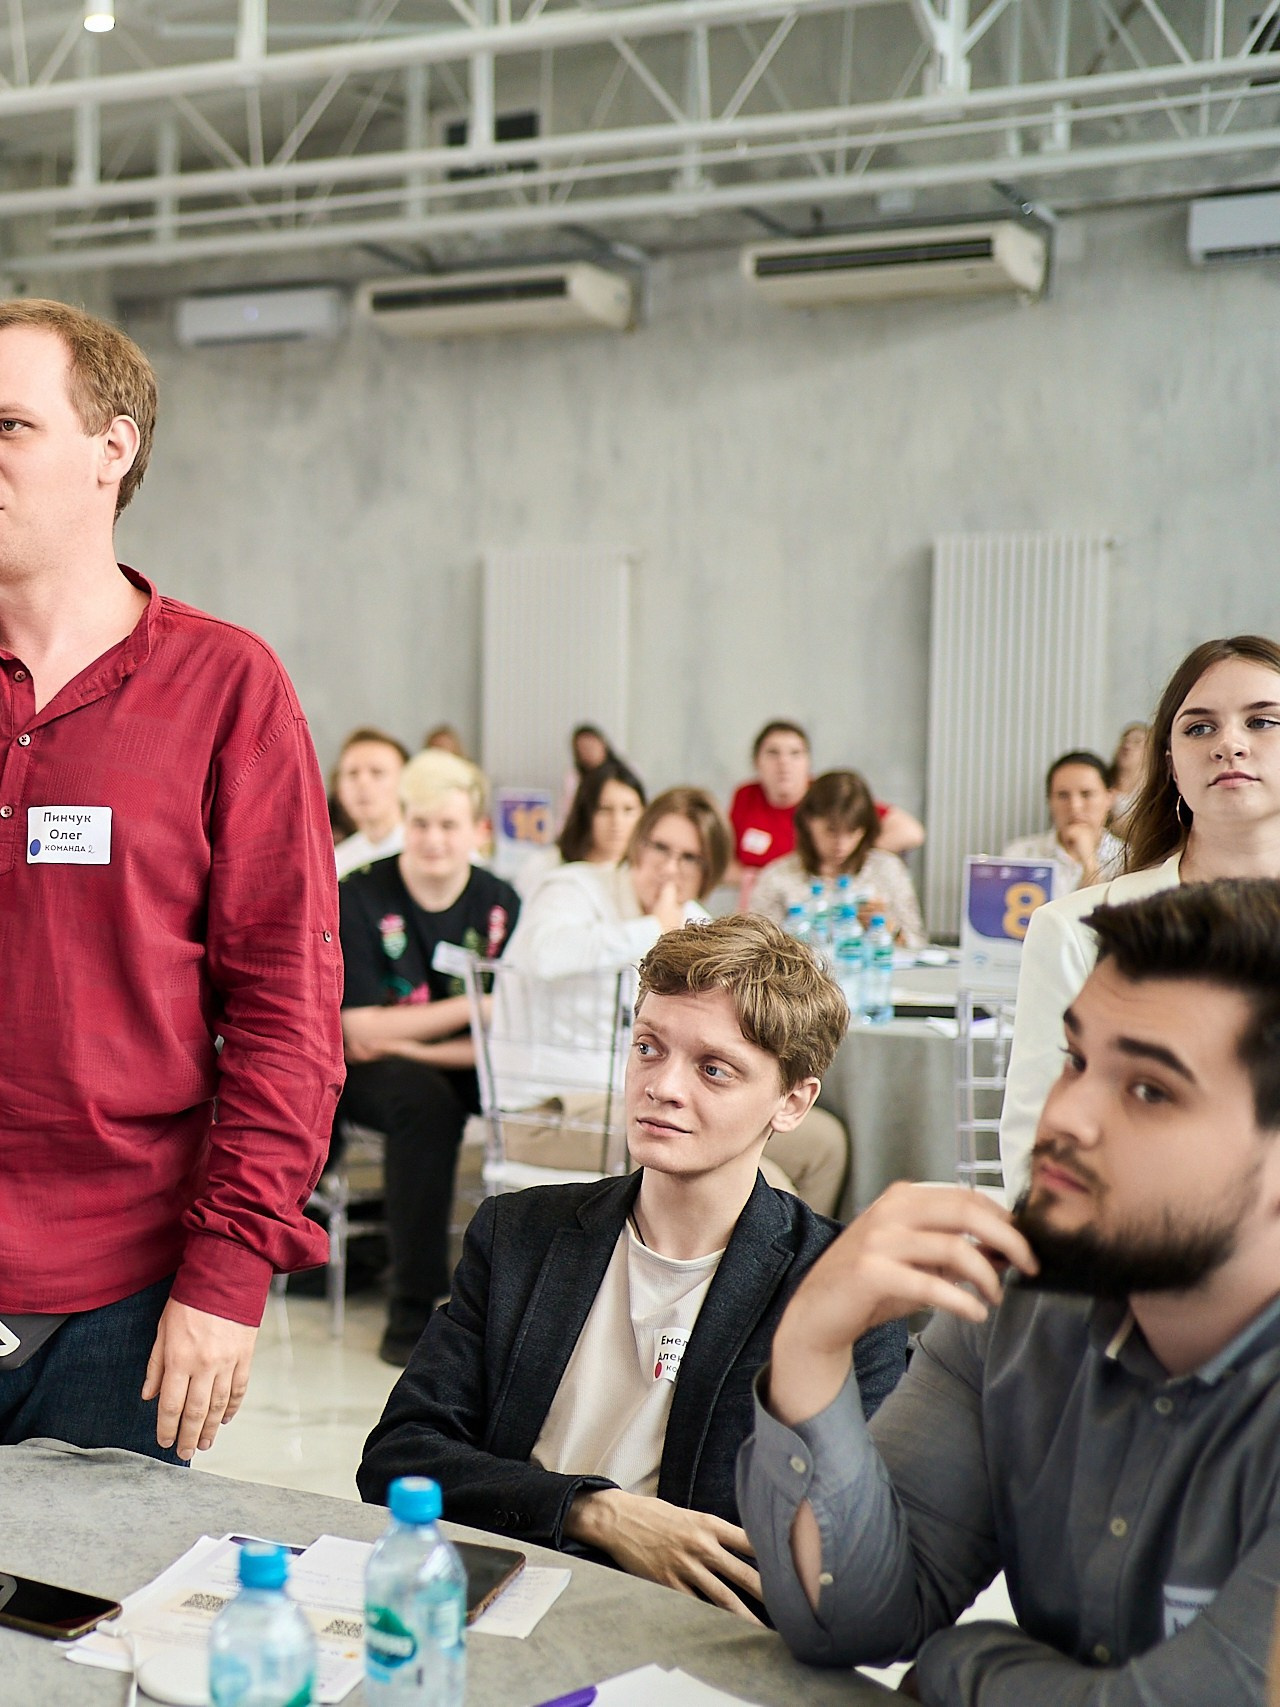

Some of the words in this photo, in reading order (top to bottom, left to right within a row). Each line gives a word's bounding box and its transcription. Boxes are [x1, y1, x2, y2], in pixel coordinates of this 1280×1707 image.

[43, 812, 92, 826] Пинчук
[49, 829, 82, 840] Олег
[87, 845, 95, 854] 2
[1002, 881, 1048, 941] 8
[661, 1335, 688, 1347] Емел
